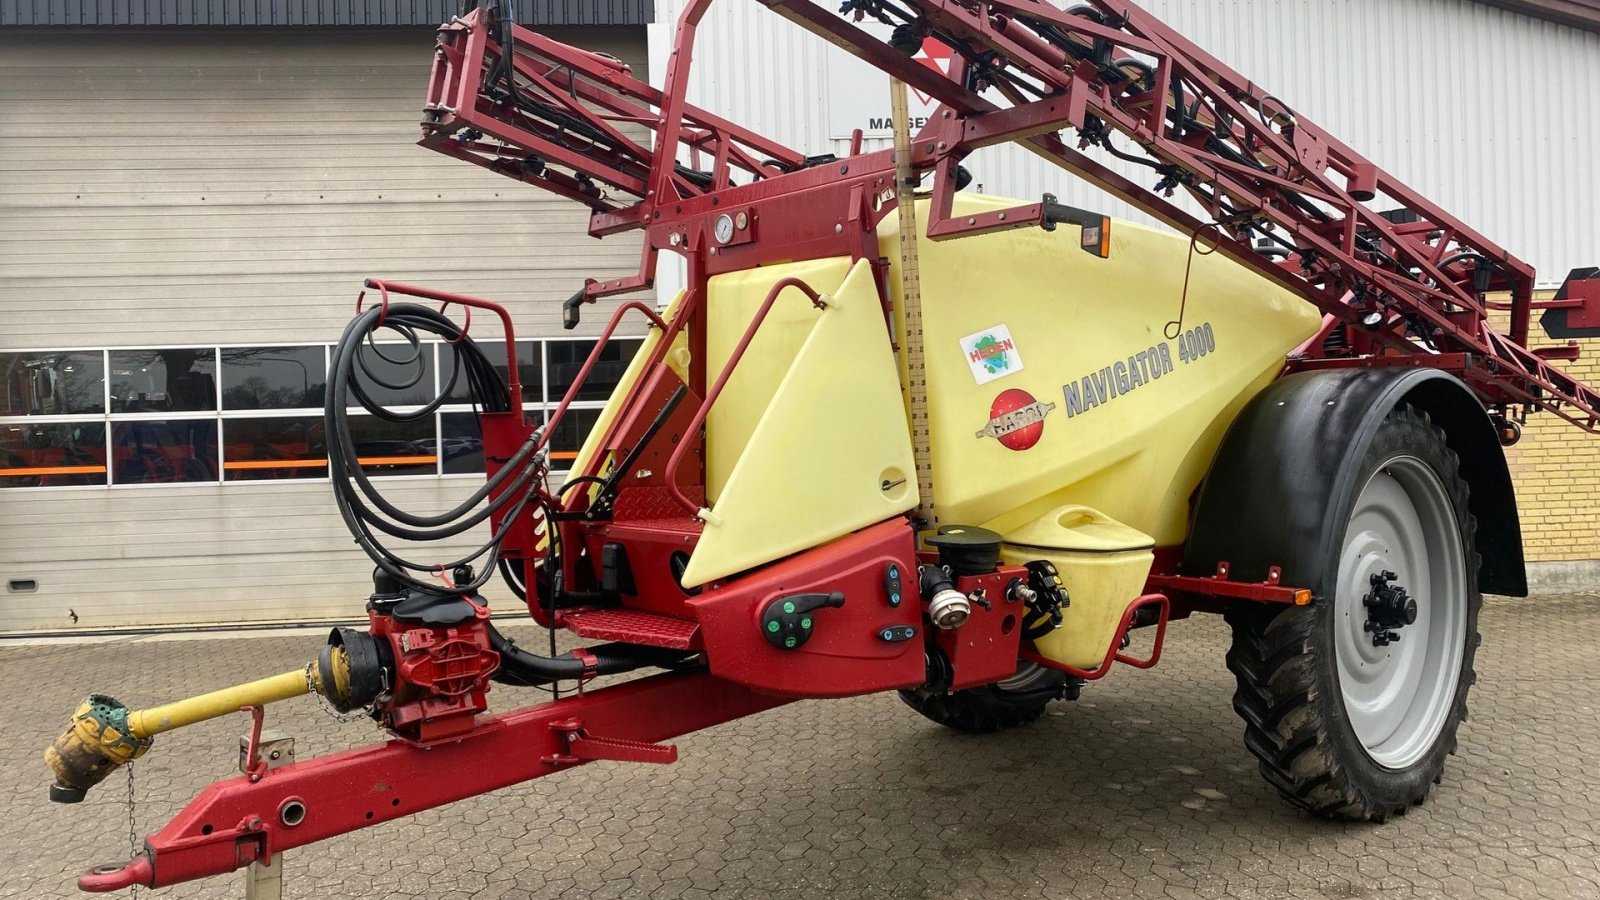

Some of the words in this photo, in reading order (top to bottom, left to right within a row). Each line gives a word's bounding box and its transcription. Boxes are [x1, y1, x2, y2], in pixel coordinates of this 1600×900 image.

[869, 118, 930, 130] MASE
[1062, 342, 1174, 419] NAVIGATOR
[1178, 322, 1216, 364] 4000
